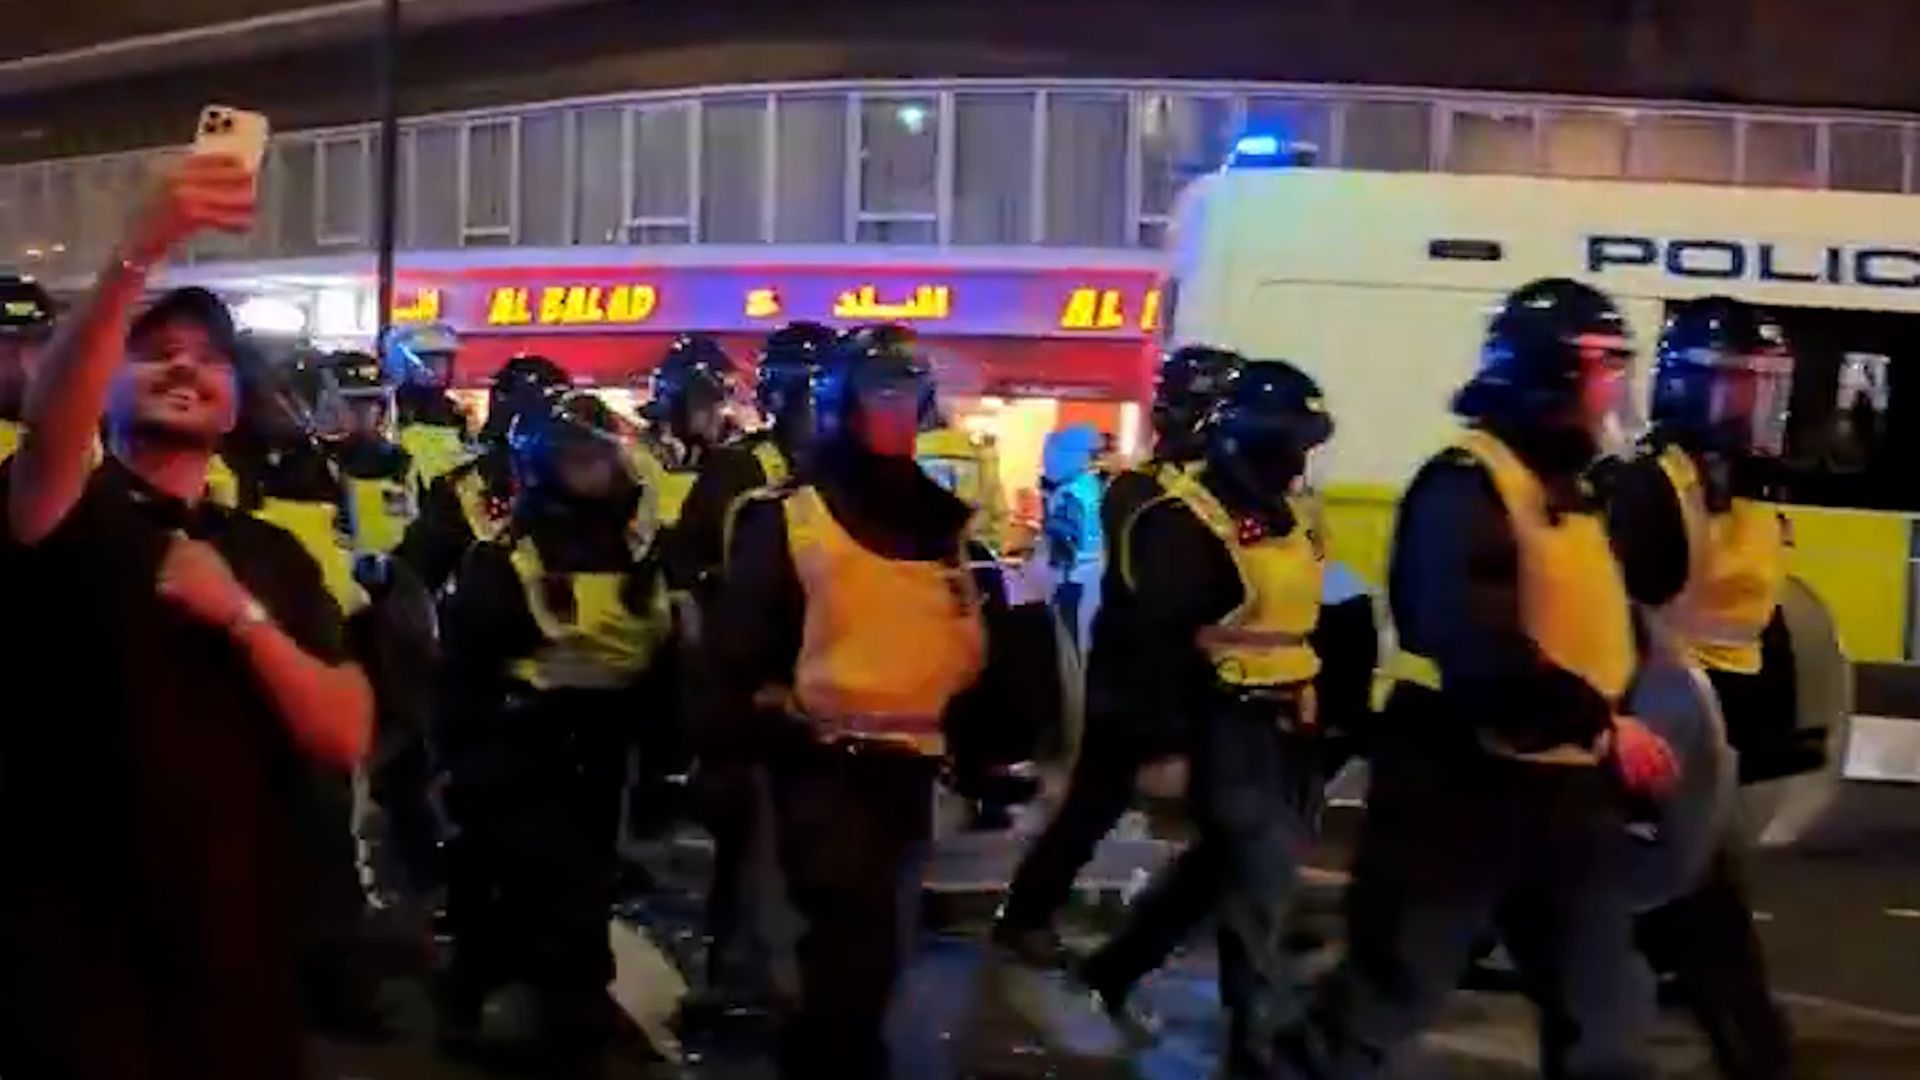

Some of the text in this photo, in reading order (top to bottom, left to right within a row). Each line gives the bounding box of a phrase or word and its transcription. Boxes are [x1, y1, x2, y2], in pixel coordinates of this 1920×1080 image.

[487, 283, 657, 325] AL BALAD
[1061, 288, 1123, 328] AL
